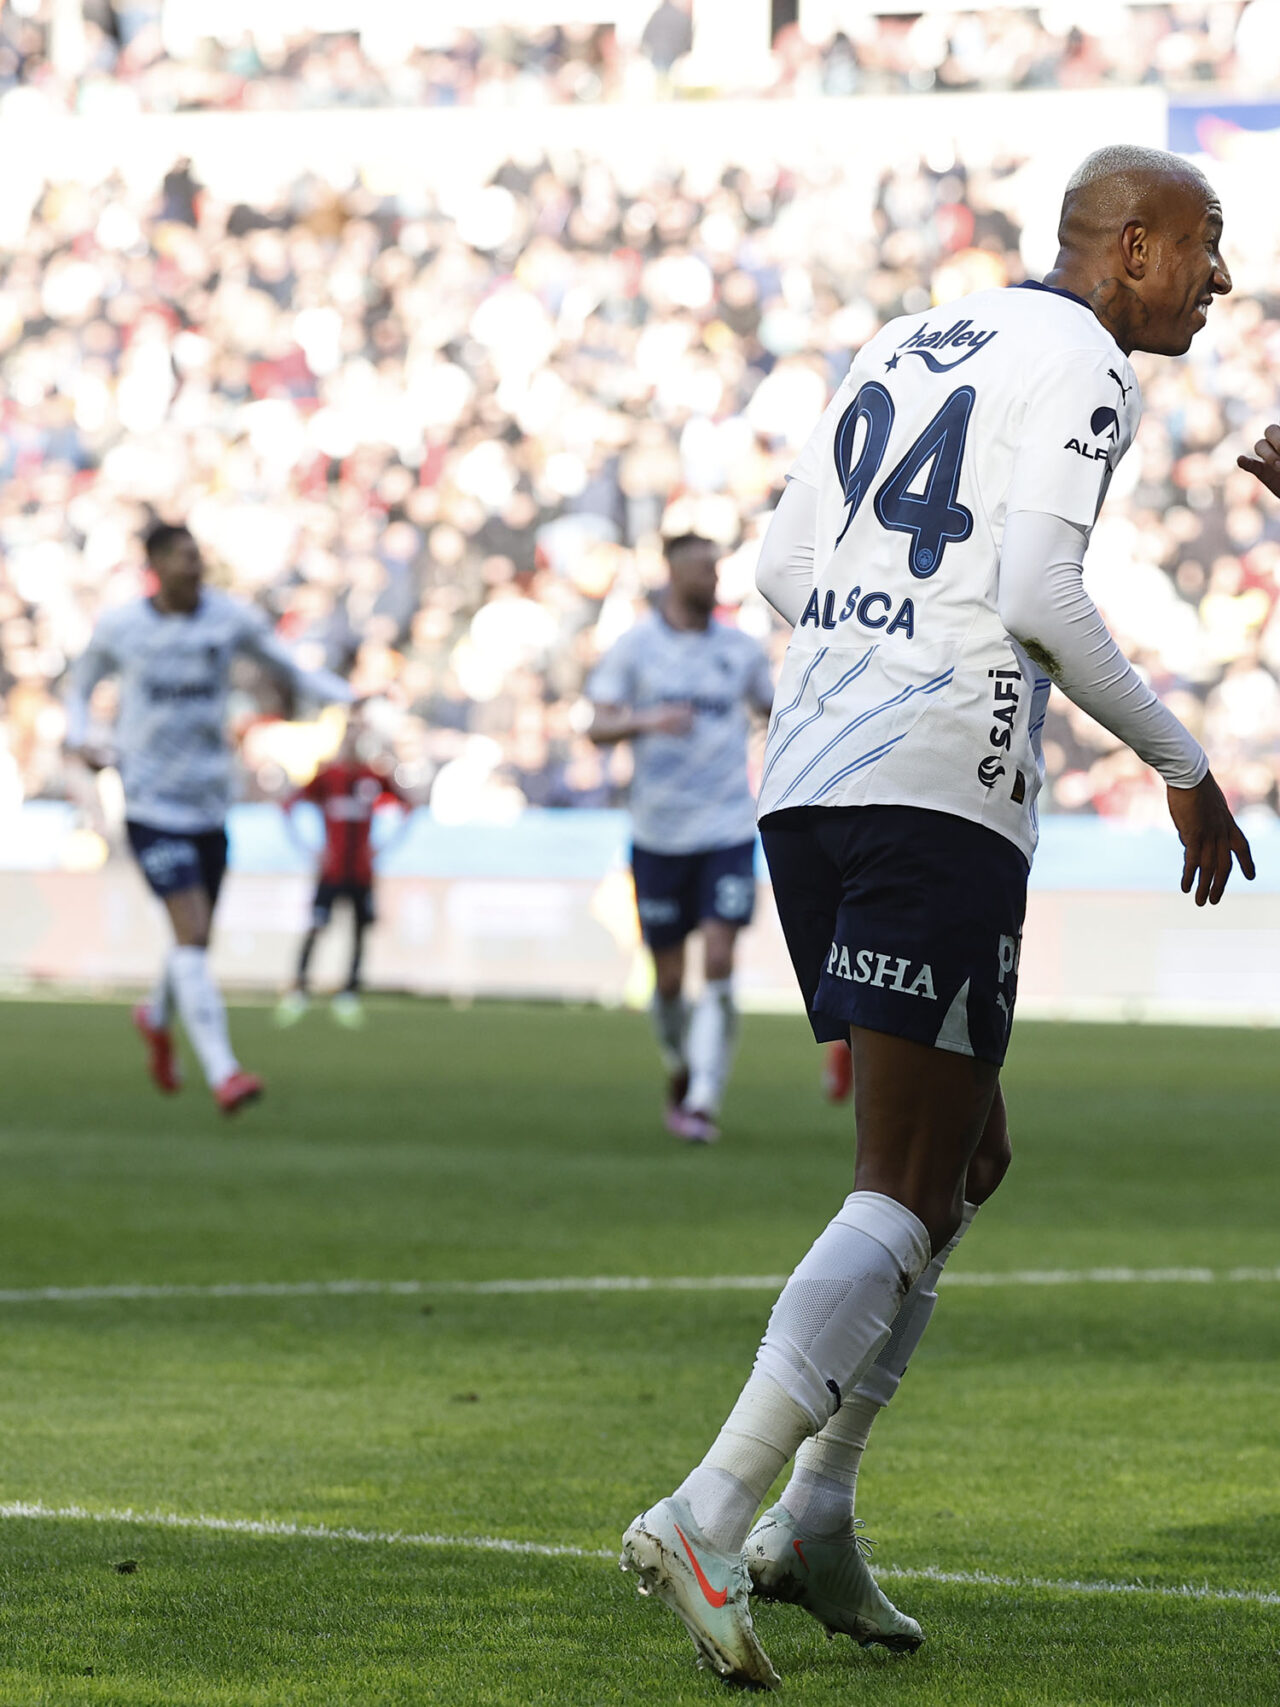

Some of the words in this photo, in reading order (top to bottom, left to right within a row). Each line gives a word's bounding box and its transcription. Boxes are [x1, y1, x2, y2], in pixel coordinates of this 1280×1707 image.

[896, 320, 998, 373] halley
[1063, 438, 1108, 461] ALP
[834, 381, 976, 579] 94
[800, 586, 915, 640] ALSCA
[826, 941, 938, 1001] PASHA
